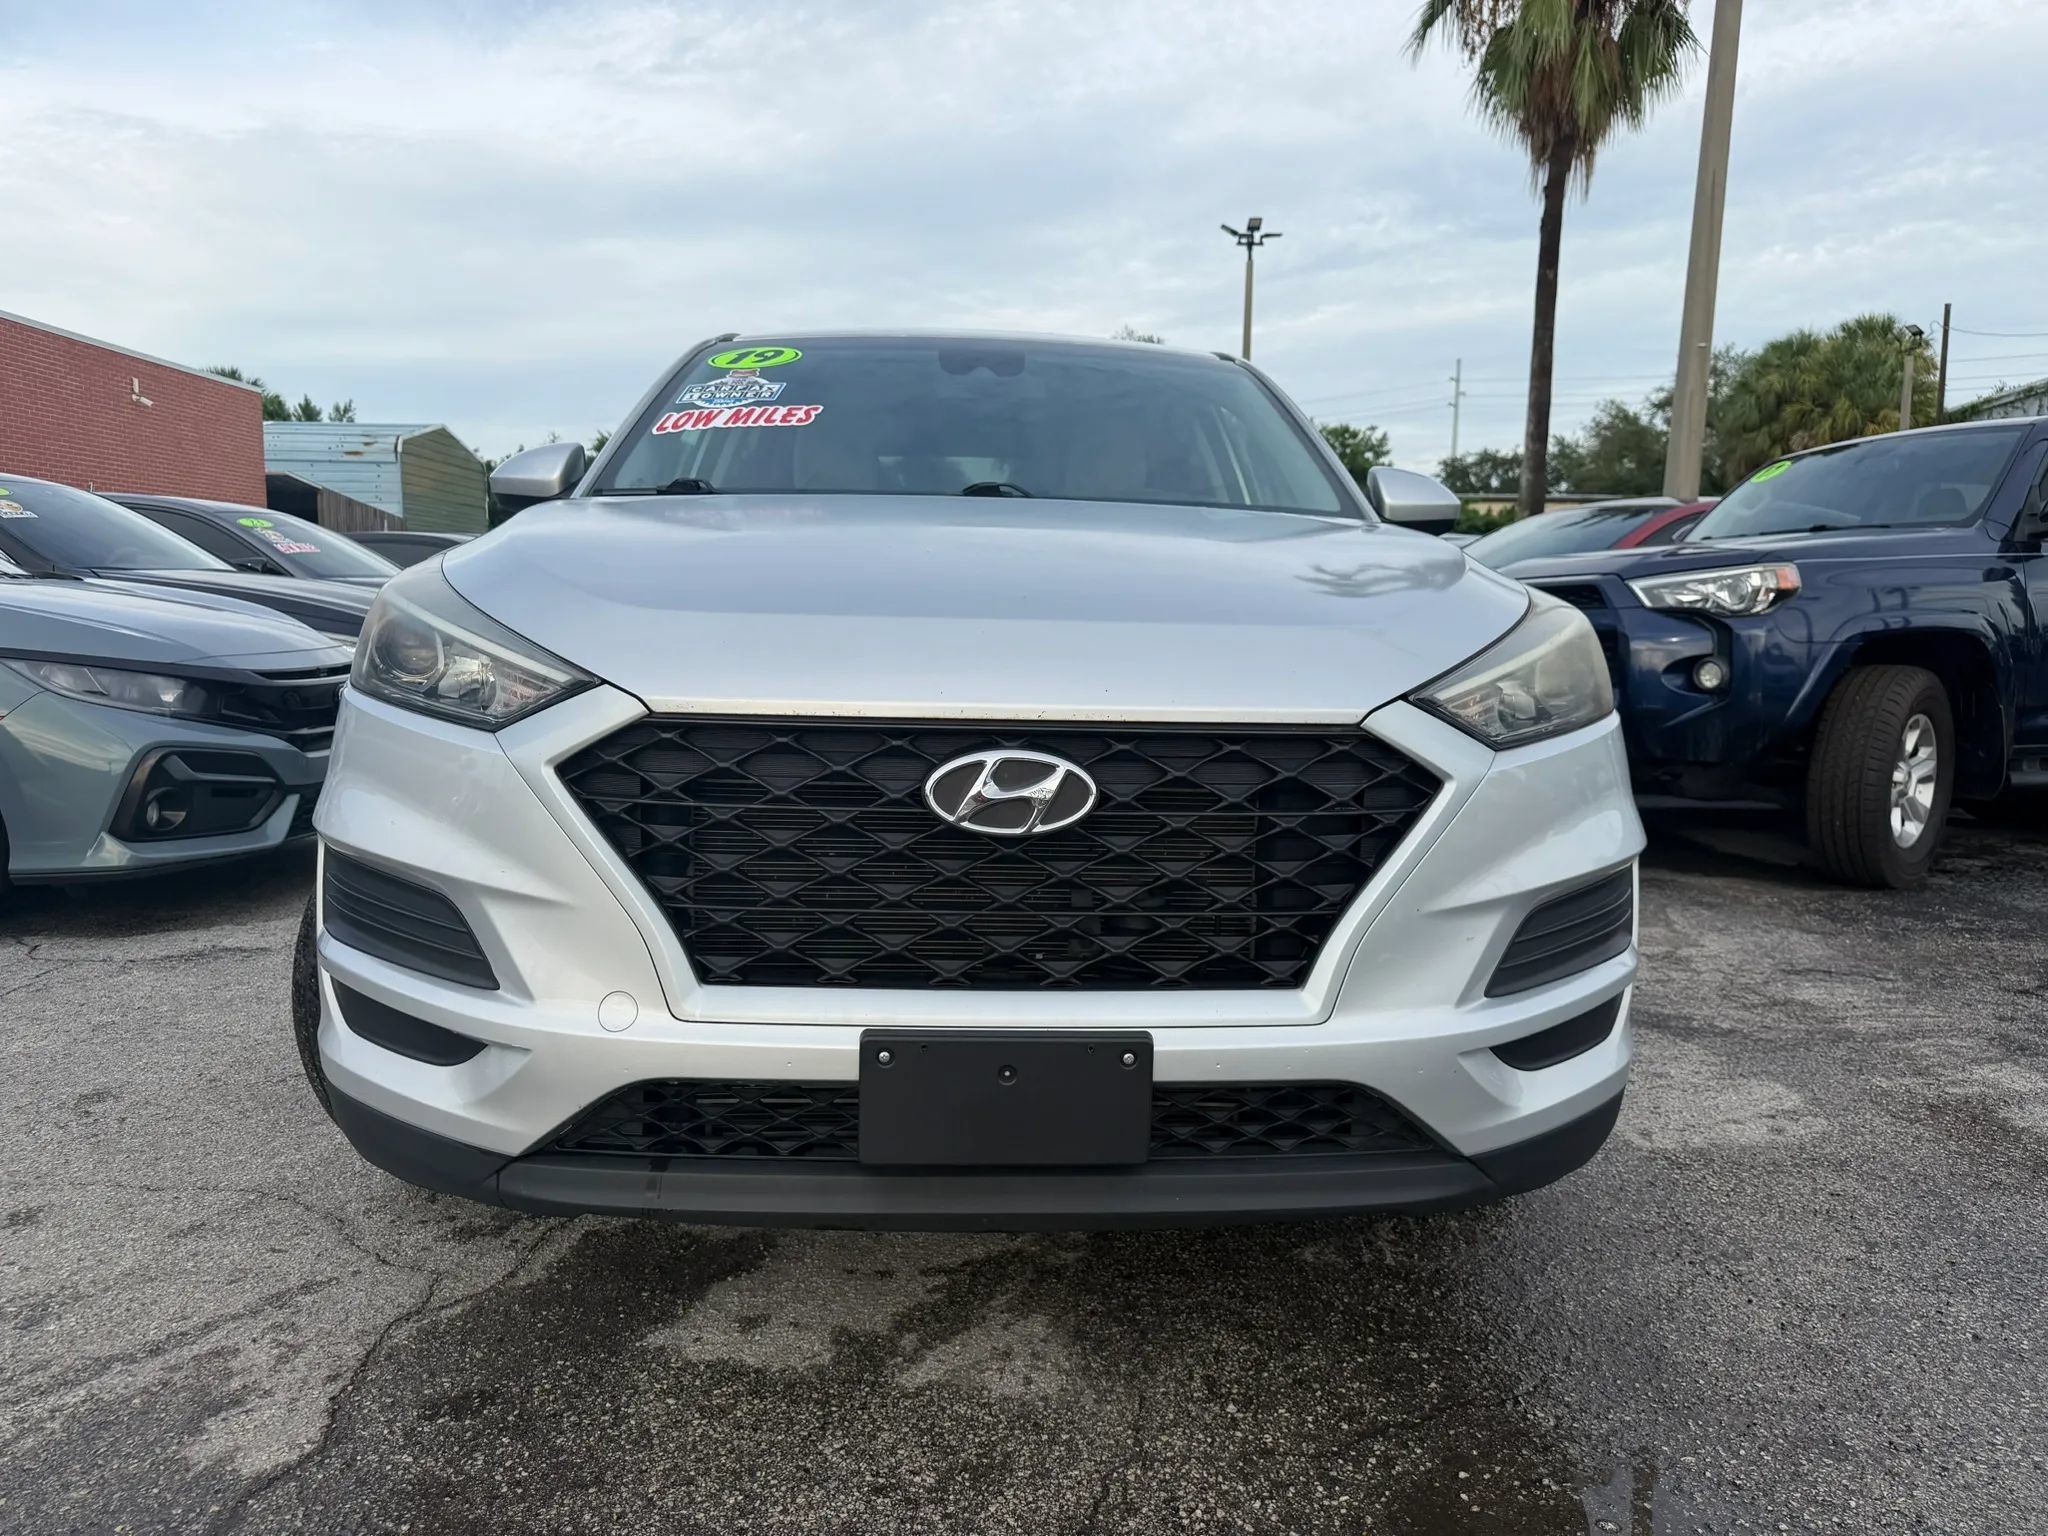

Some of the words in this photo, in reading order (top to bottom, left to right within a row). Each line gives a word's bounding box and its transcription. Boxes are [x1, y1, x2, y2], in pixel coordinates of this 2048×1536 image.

[727, 350, 785, 364] 19
[692, 384, 780, 393] CARFAX
[702, 391, 772, 399] OWNER
[655, 410, 723, 432] LOW
[724, 406, 822, 426] MILES
